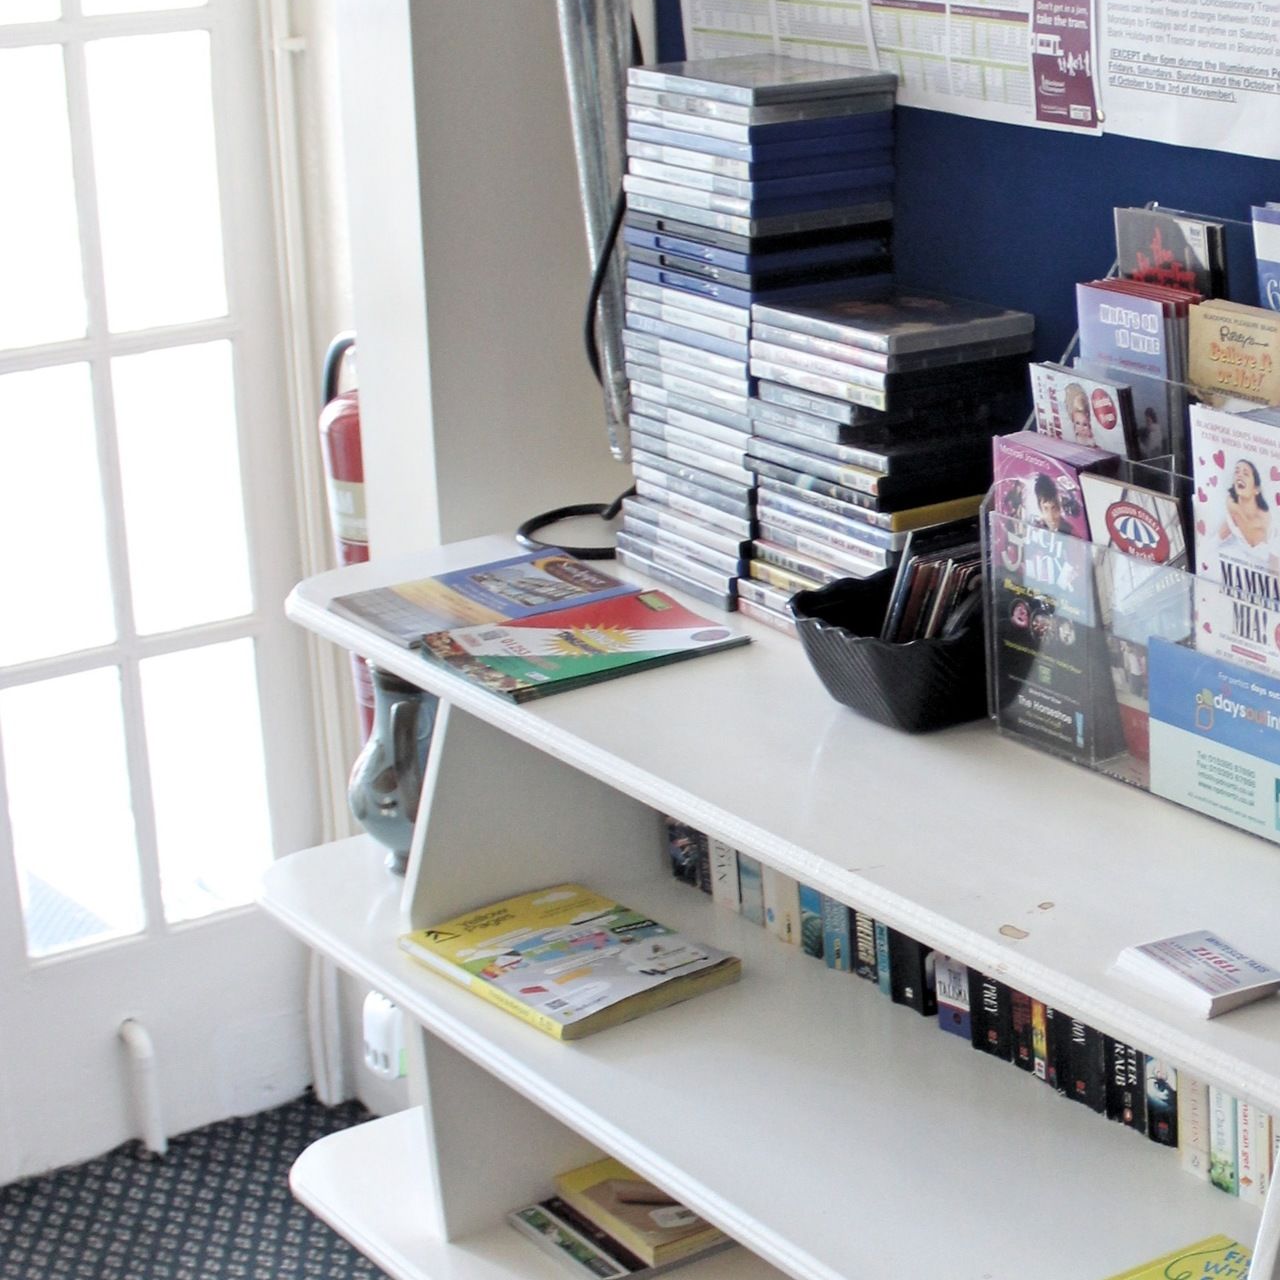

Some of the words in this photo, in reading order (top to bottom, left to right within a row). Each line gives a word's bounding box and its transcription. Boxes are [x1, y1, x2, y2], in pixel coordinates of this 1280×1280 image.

[1036, 12, 1052, 23] take
[1054, 14, 1066, 26] the
[1141, 314, 1159, 334] ON
[1115, 329, 1129, 348] IN
[1130, 333, 1160, 355] WYRE
[1209, 342, 1256, 369] Believe
[1216, 369, 1232, 384] or
[1234, 369, 1265, 392] Not!
[1128, 546, 1156, 561] Market
[1219, 560, 1280, 602] MAMMA
[1233, 601, 1268, 645] MIA!
[1018, 695, 1032, 708] The
[1033, 700, 1072, 724] Horseshoe
[982, 983, 998, 1013] PREY
[1114, 1043, 1126, 1087] RAUB
[1127, 1045, 1137, 1086] ETER
[1241, 1150, 1249, 1170] get
